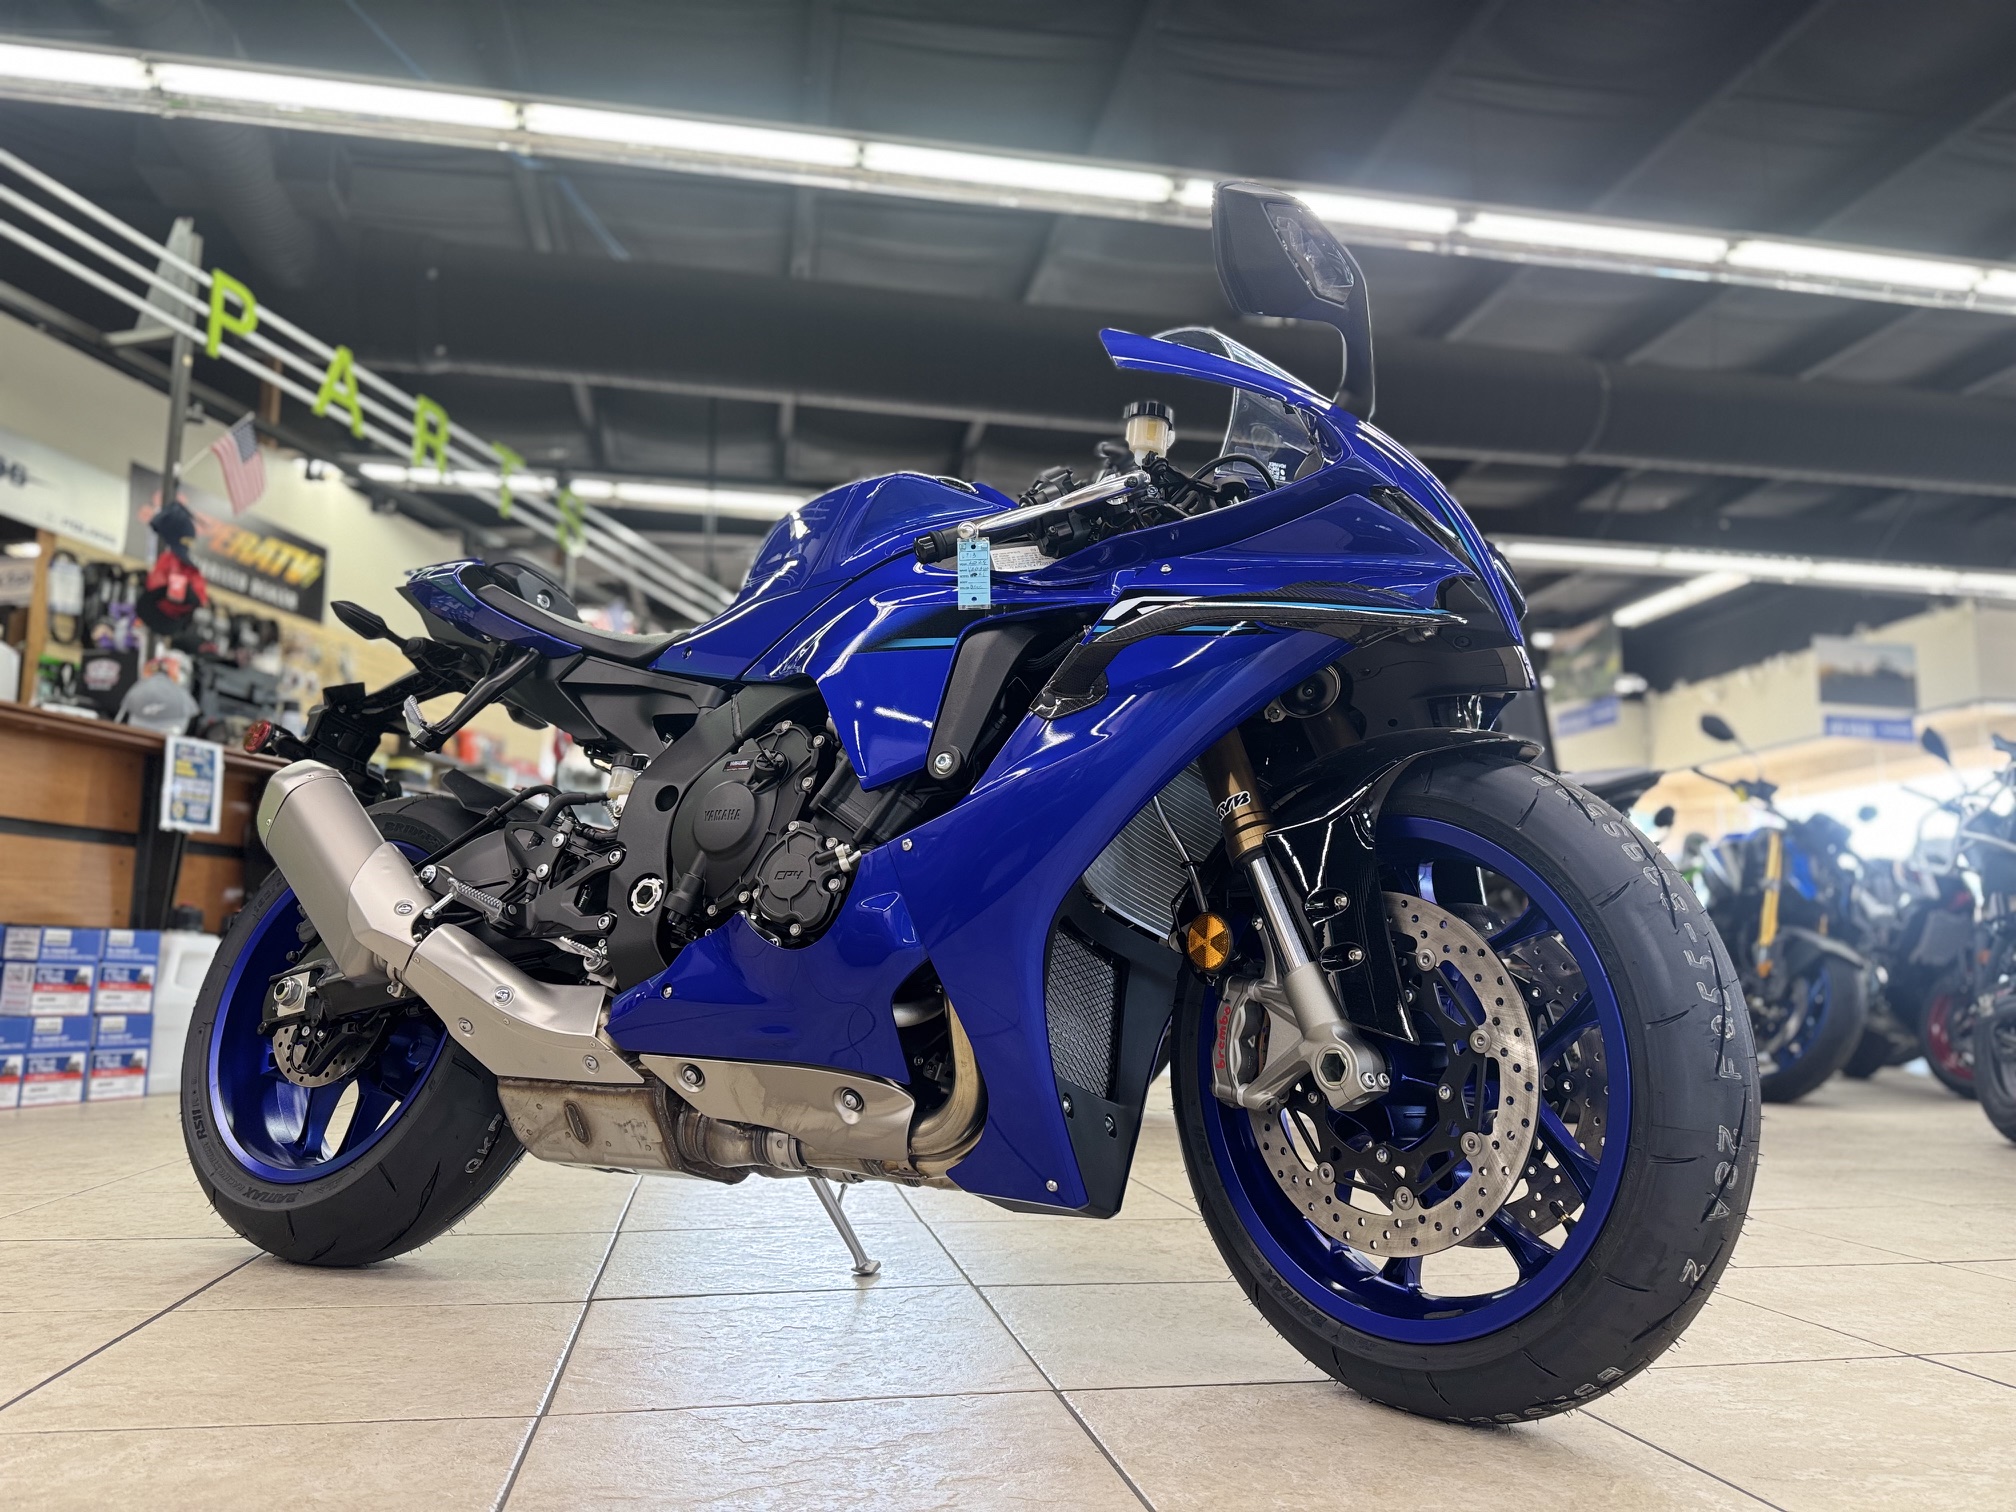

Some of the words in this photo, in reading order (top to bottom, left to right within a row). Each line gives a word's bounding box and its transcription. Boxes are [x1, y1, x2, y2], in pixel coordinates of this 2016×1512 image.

[206, 267, 588, 556] PARTS
[704, 809, 741, 821] YAMAHA
[1215, 1005, 1231, 1069] brembo
